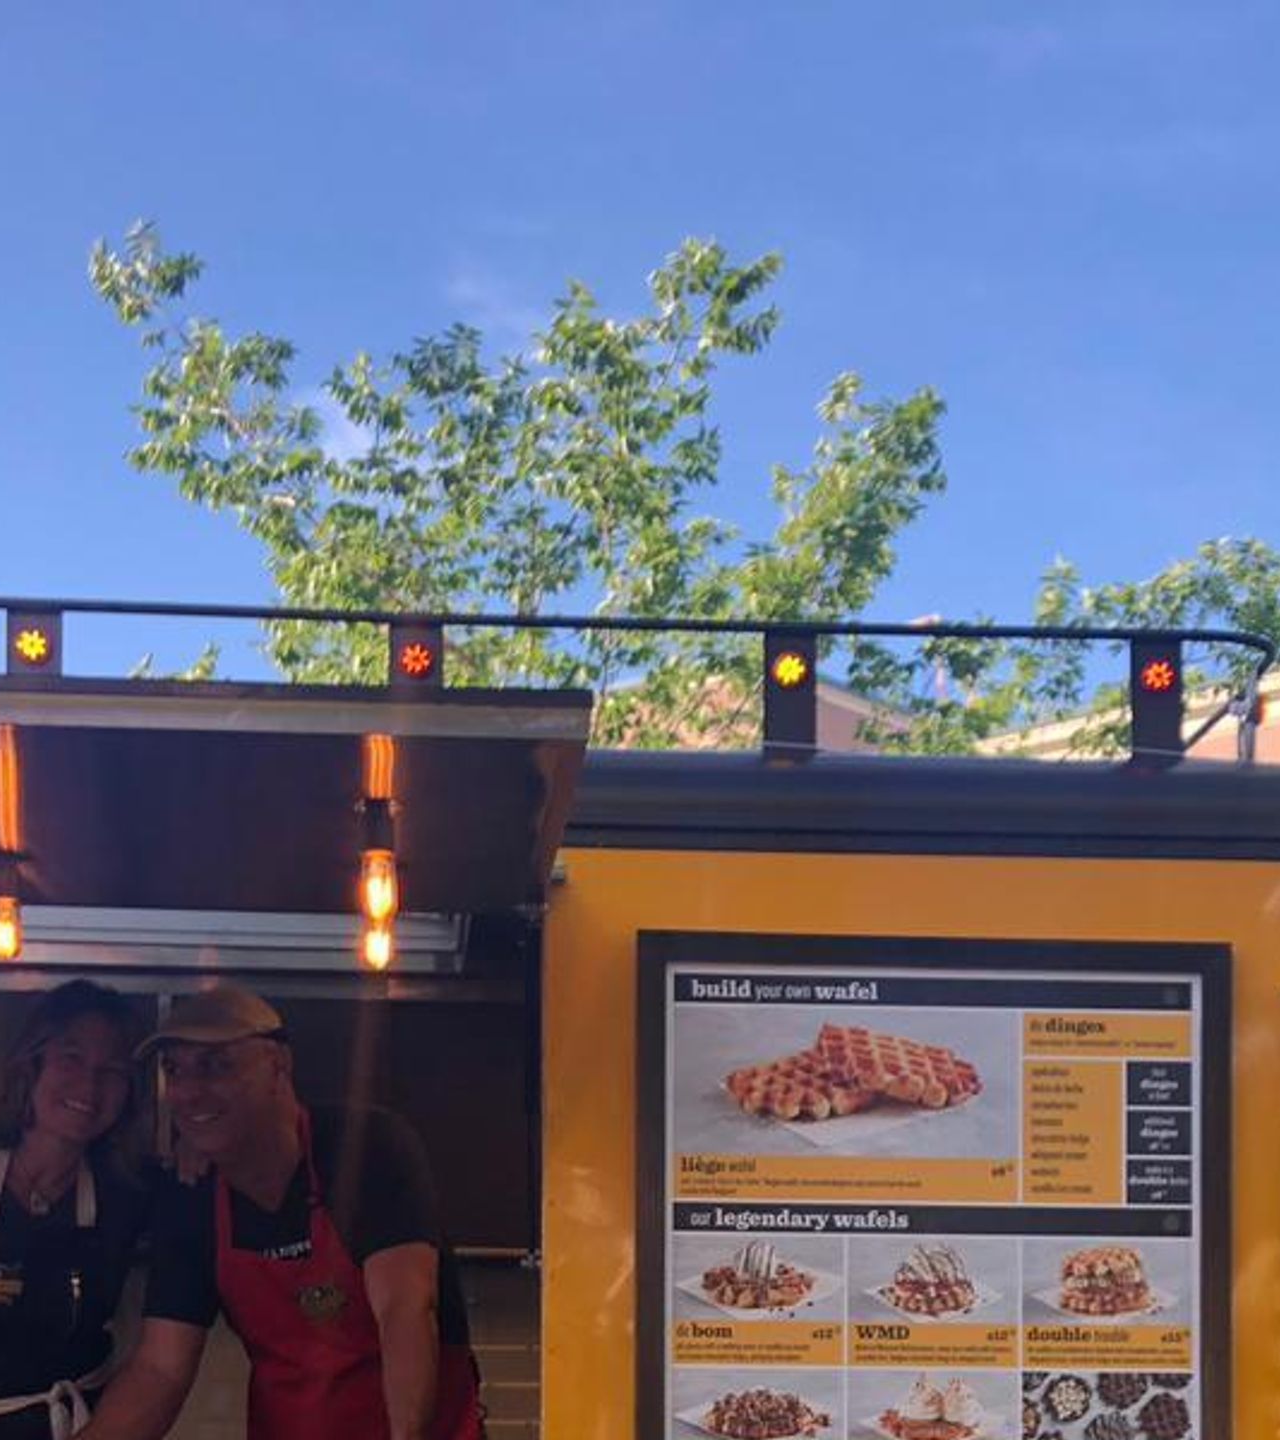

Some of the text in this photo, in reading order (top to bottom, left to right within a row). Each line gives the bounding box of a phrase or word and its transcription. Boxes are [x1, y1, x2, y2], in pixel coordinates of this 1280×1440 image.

[691, 979, 879, 1001] build your own wafel
[690, 1208, 909, 1230] our legendary wafels
[691, 1324, 733, 1339] bom
[855, 1324, 910, 1341] WMD
[1027, 1327, 1092, 1342] double
